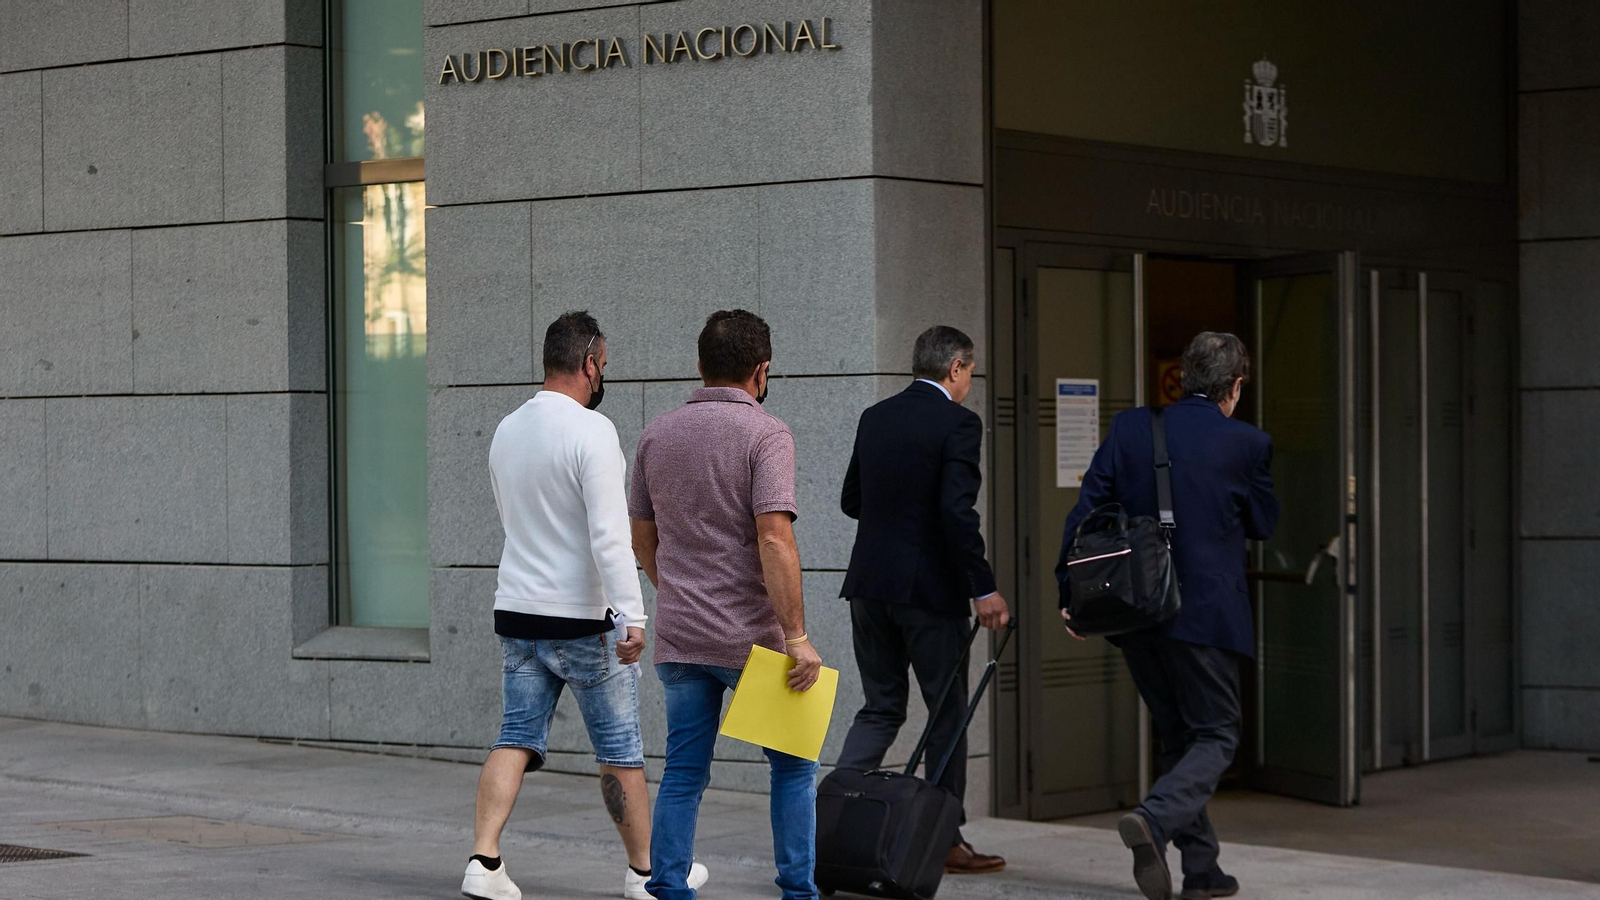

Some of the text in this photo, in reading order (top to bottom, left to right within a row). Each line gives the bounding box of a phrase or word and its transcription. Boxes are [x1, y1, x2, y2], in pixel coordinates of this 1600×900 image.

[438, 17, 838, 85] AUDIENCIA NACIONAL
[1147, 188, 1376, 233] AUDIENCIA NACIONAL
